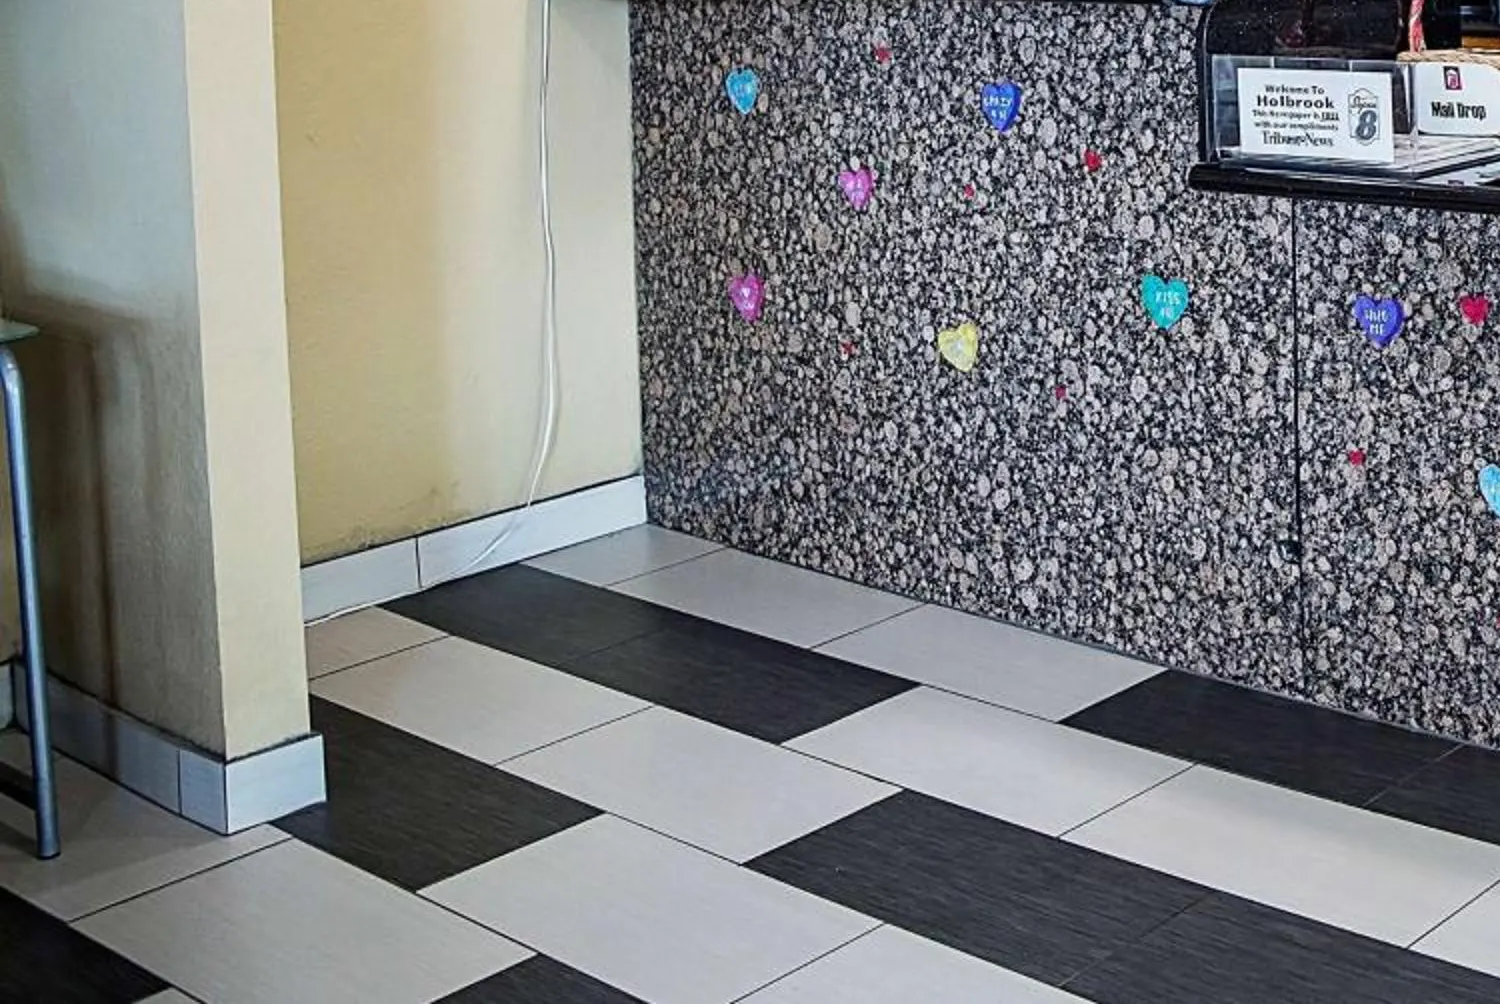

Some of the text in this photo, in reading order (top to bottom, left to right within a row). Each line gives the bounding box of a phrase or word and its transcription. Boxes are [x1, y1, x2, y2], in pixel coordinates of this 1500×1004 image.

[1311, 85, 1325, 95] To
[1257, 95, 1335, 109] Holbrook
[1431, 102, 1487, 121] Mail Drop
[1356, 110, 1378, 140] 8
